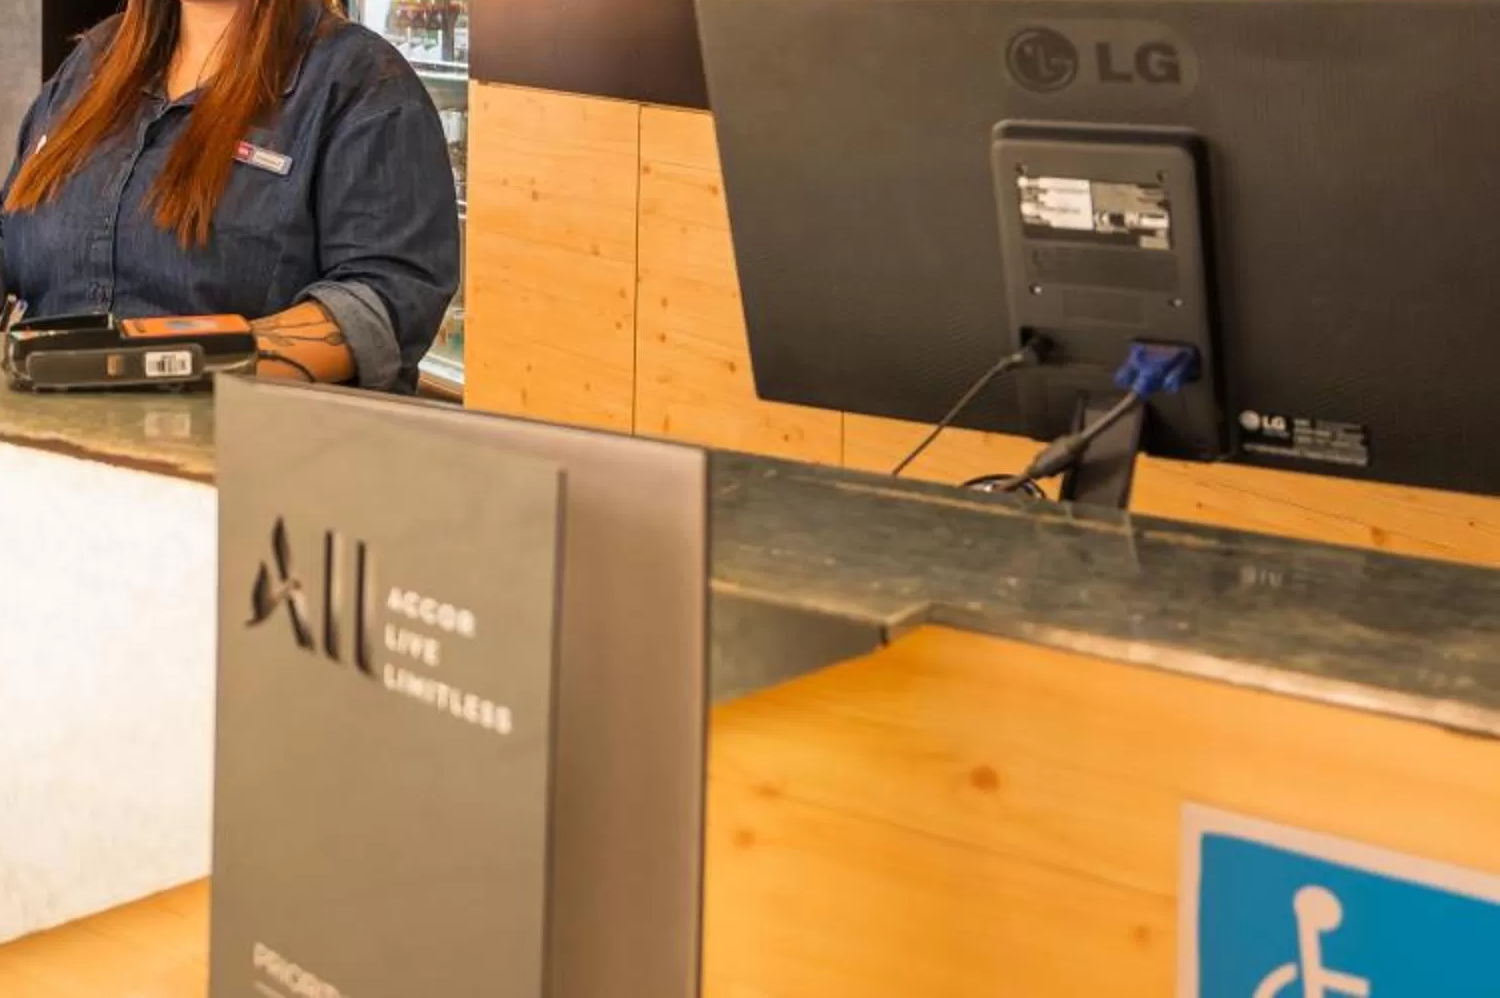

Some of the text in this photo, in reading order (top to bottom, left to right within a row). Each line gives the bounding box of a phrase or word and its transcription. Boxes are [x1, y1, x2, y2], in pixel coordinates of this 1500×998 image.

[1095, 41, 1182, 84] LG
[1261, 415, 1286, 432] LG
[244, 515, 377, 681] All
[387, 587, 477, 639] ACCOR
[384, 622, 441, 667] LIVE
[382, 662, 513, 736] LIMITLESS
